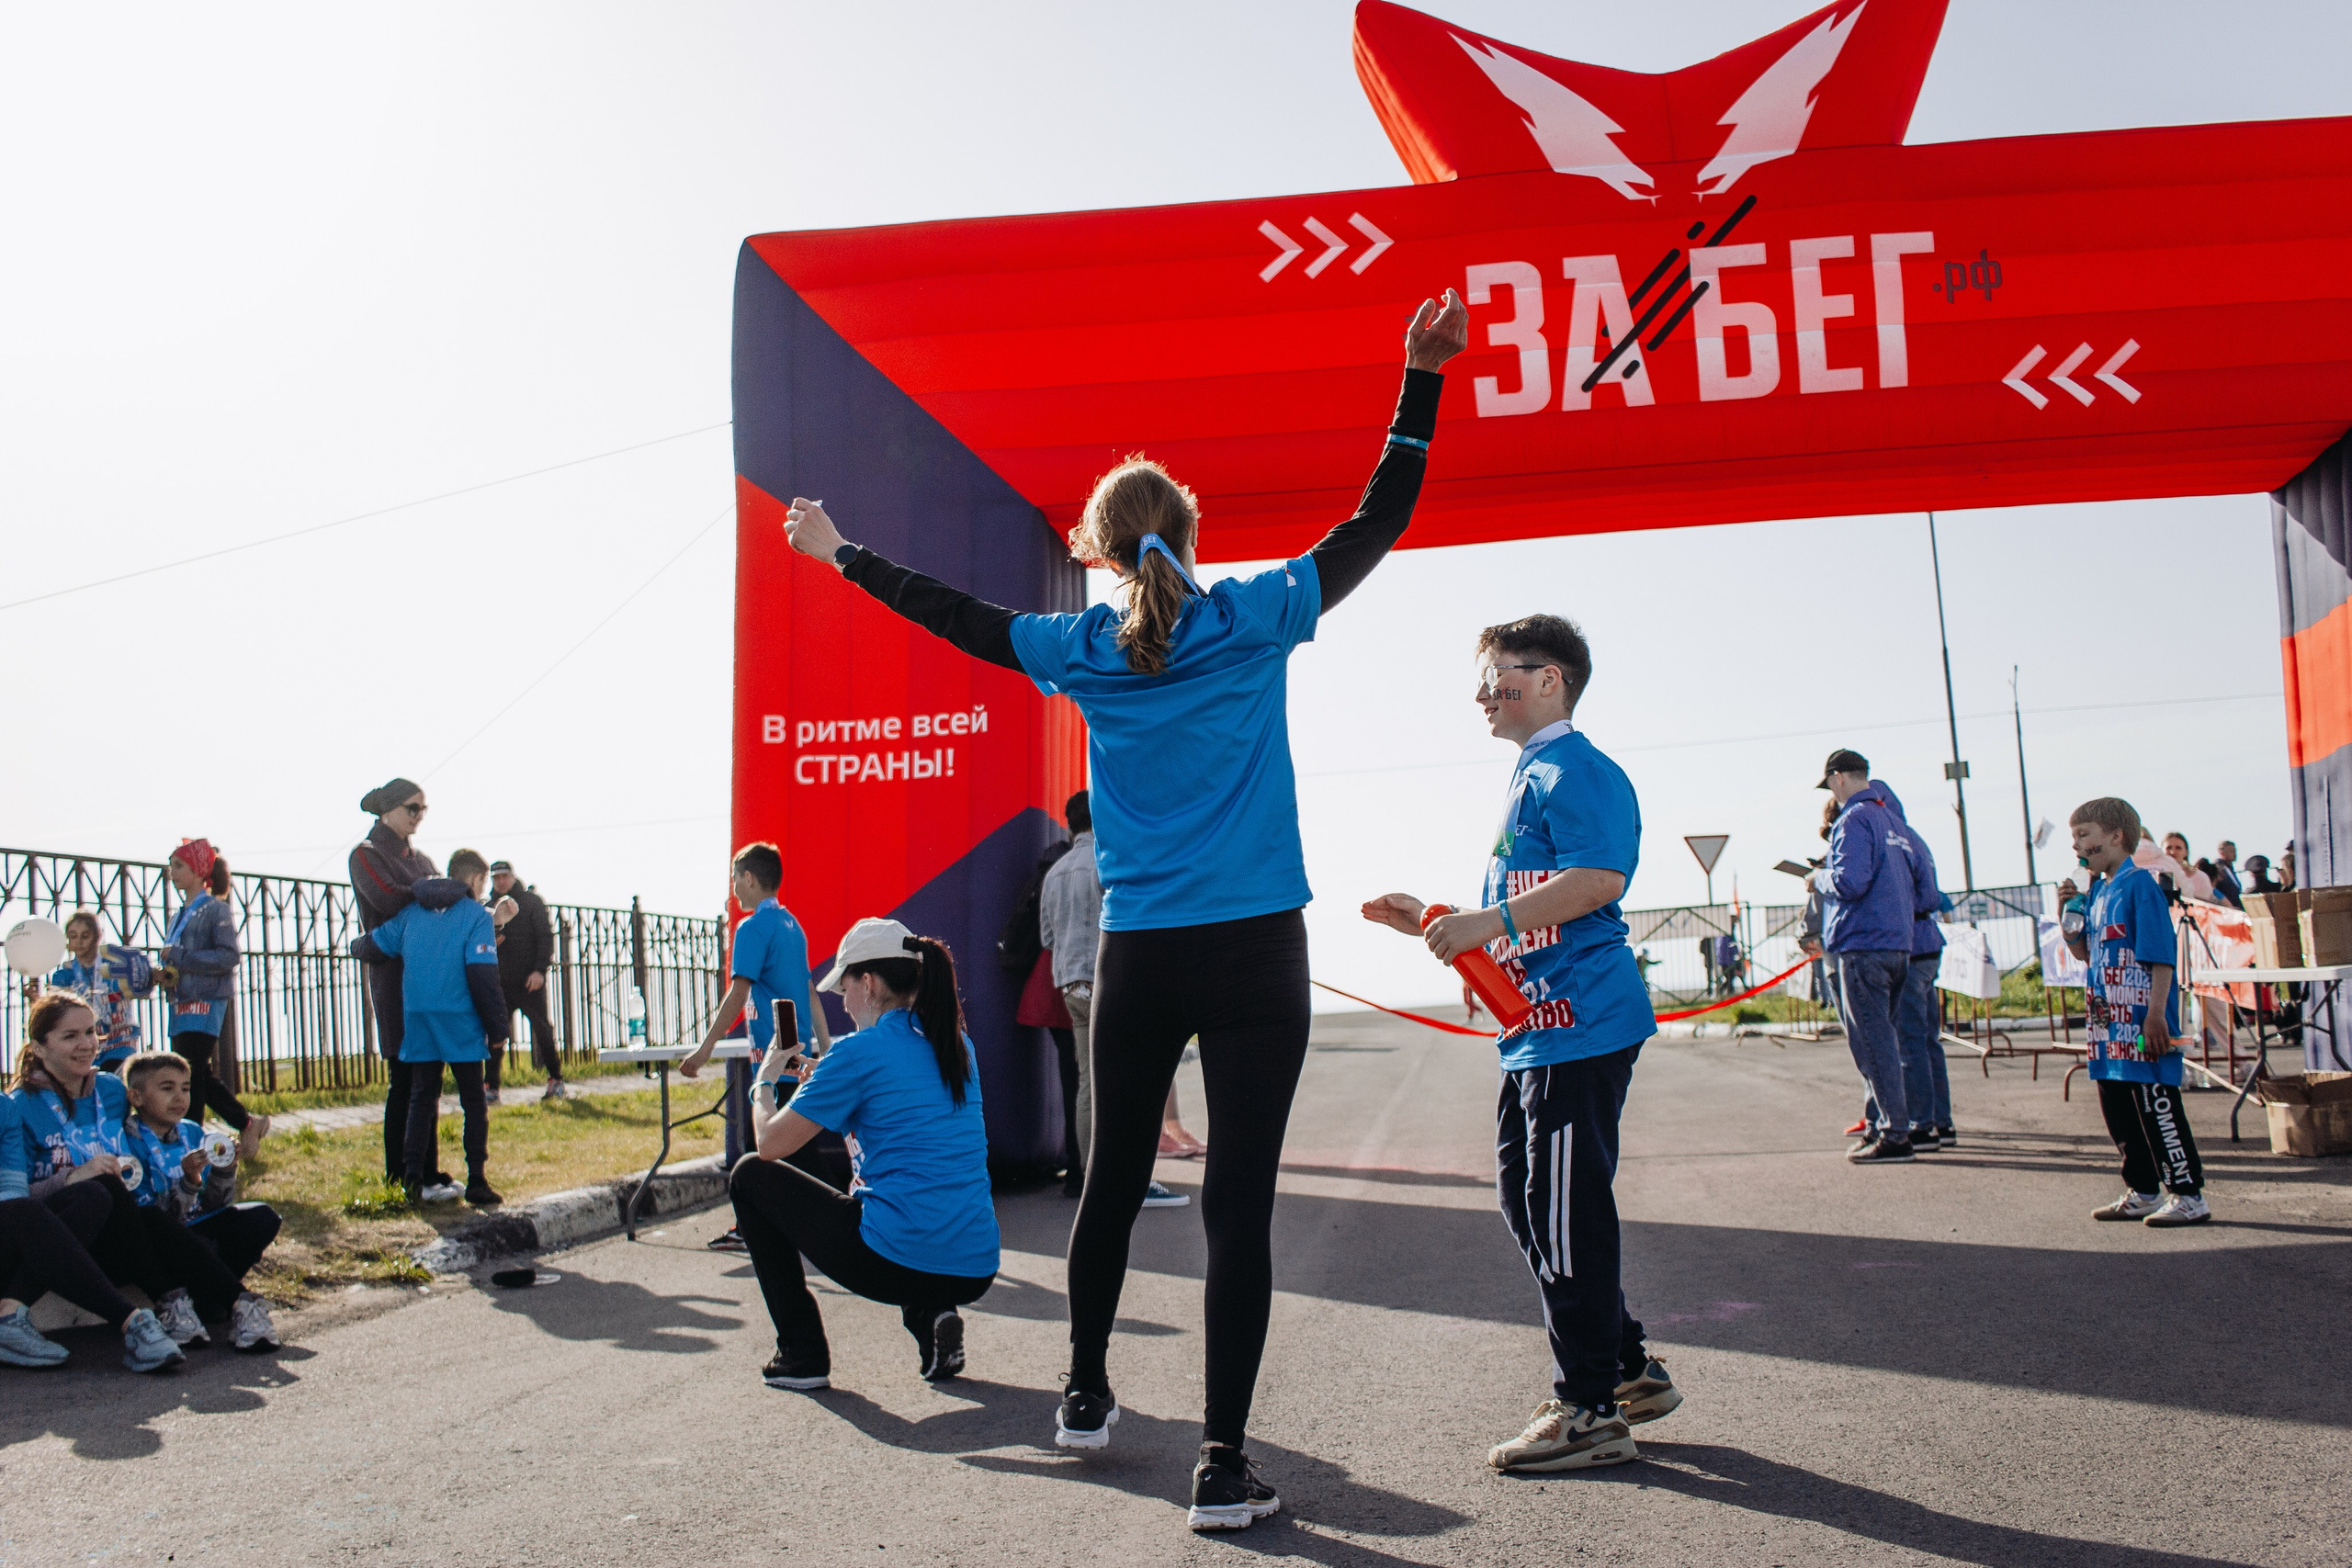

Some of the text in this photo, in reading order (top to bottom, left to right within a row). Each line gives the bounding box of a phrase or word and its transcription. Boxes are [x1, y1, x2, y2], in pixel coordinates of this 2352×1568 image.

[1465, 254, 1655, 418] ЗА
[1689, 231, 1935, 401] БЕГ
[763, 704, 989, 749] В ритме всей
[795, 748, 955, 784] СТРАНЫ!
[2126, 967, 2152, 987] 202
[2105, 985, 2152, 1006] МОМЕН
[2116, 1022, 2141, 1043] 202
[2152, 1083, 2193, 1184] COMMENT
